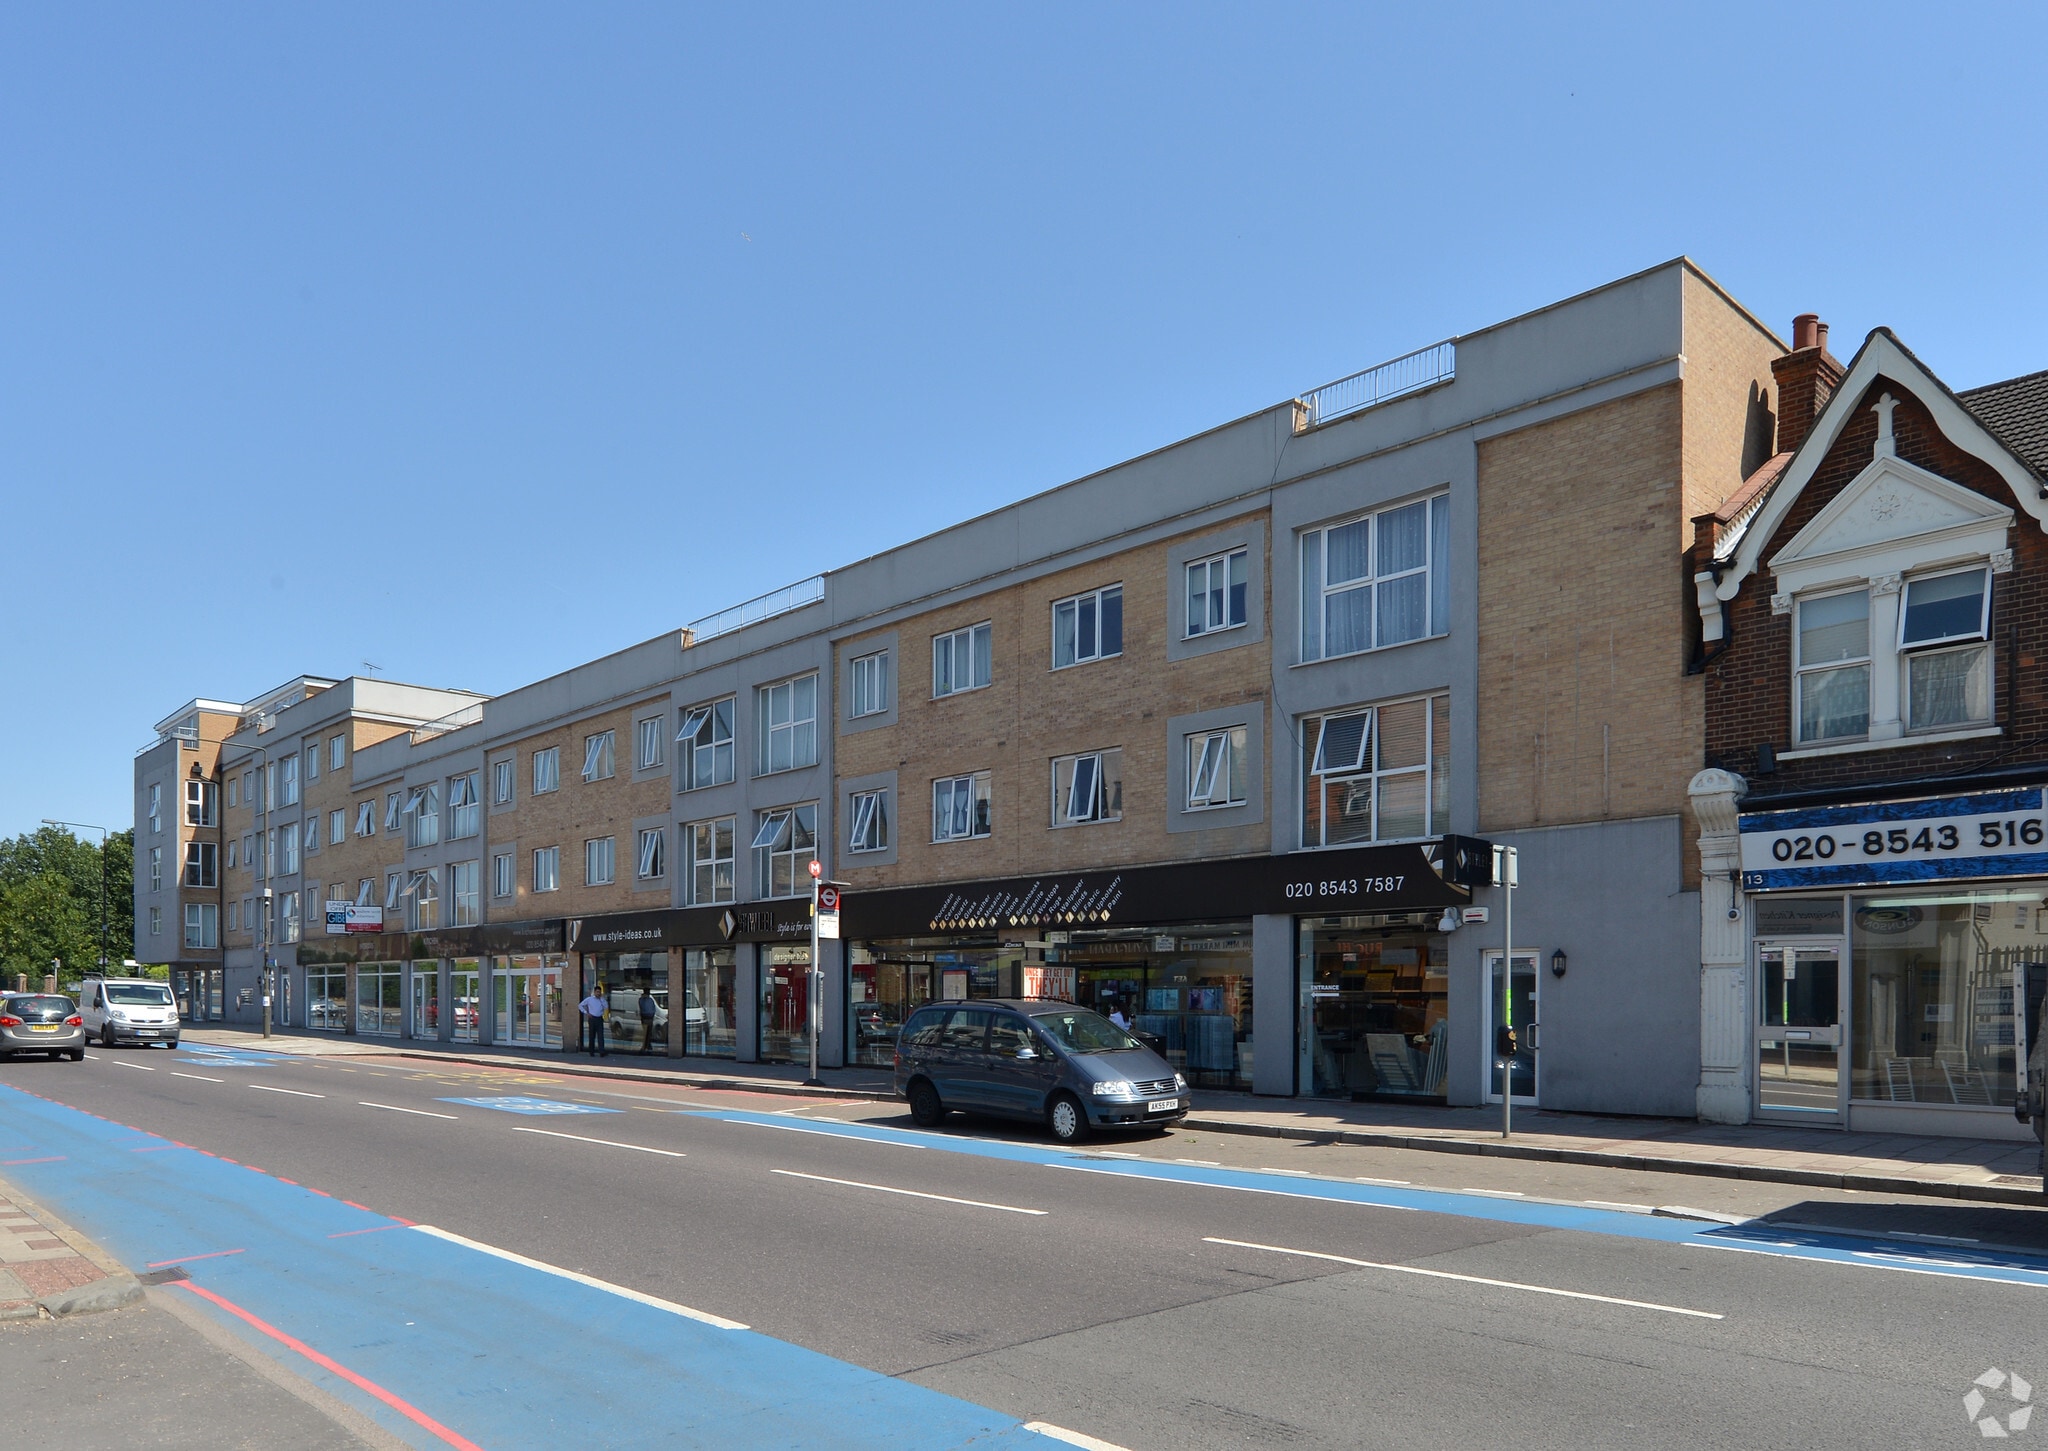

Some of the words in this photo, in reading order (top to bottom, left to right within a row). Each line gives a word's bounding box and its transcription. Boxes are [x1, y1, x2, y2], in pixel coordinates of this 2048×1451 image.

[1979, 819, 2043, 848] 516
[811, 864, 820, 872] M
[1746, 874, 1763, 884] 13
[1016, 880, 1040, 916] Splashbacks
[1060, 879, 1084, 913] Wallpaper
[1096, 875, 1121, 911] Upholstery
[1286, 882, 1312, 898] 020
[1320, 879, 1358, 896] 8543
[1364, 876, 1404, 892] 7587
[934, 893, 954, 922] Porcelain
[944, 896, 961, 920] Ceramic
[954, 899, 968, 920] Quartz
[964, 902, 976, 919] Glass
[974, 894, 990, 919] Leather
[984, 892, 1002, 918] Mosaics
[994, 892, 1012, 918] Natural
[1005, 897, 1019, 916] Stone
[1026, 890, 1044, 915] Granite
[1038, 884, 1060, 914] Worktops
[1048, 896, 1062, 914] Rugs
[1072, 890, 1088, 912] Blinds
[1083, 888, 1100, 912] Fabric
[1108, 890, 1122, 910] Paint
[593, 928, 662, 942] www.style-ideas.co.uk
[1025, 968, 1038, 976] ONCE
[1040, 968, 1052, 977] THEY
[1054, 968, 1063, 977] GET
[1064, 968, 1074, 977] OUT
[1029, 978, 1070, 995] THEY'LL
